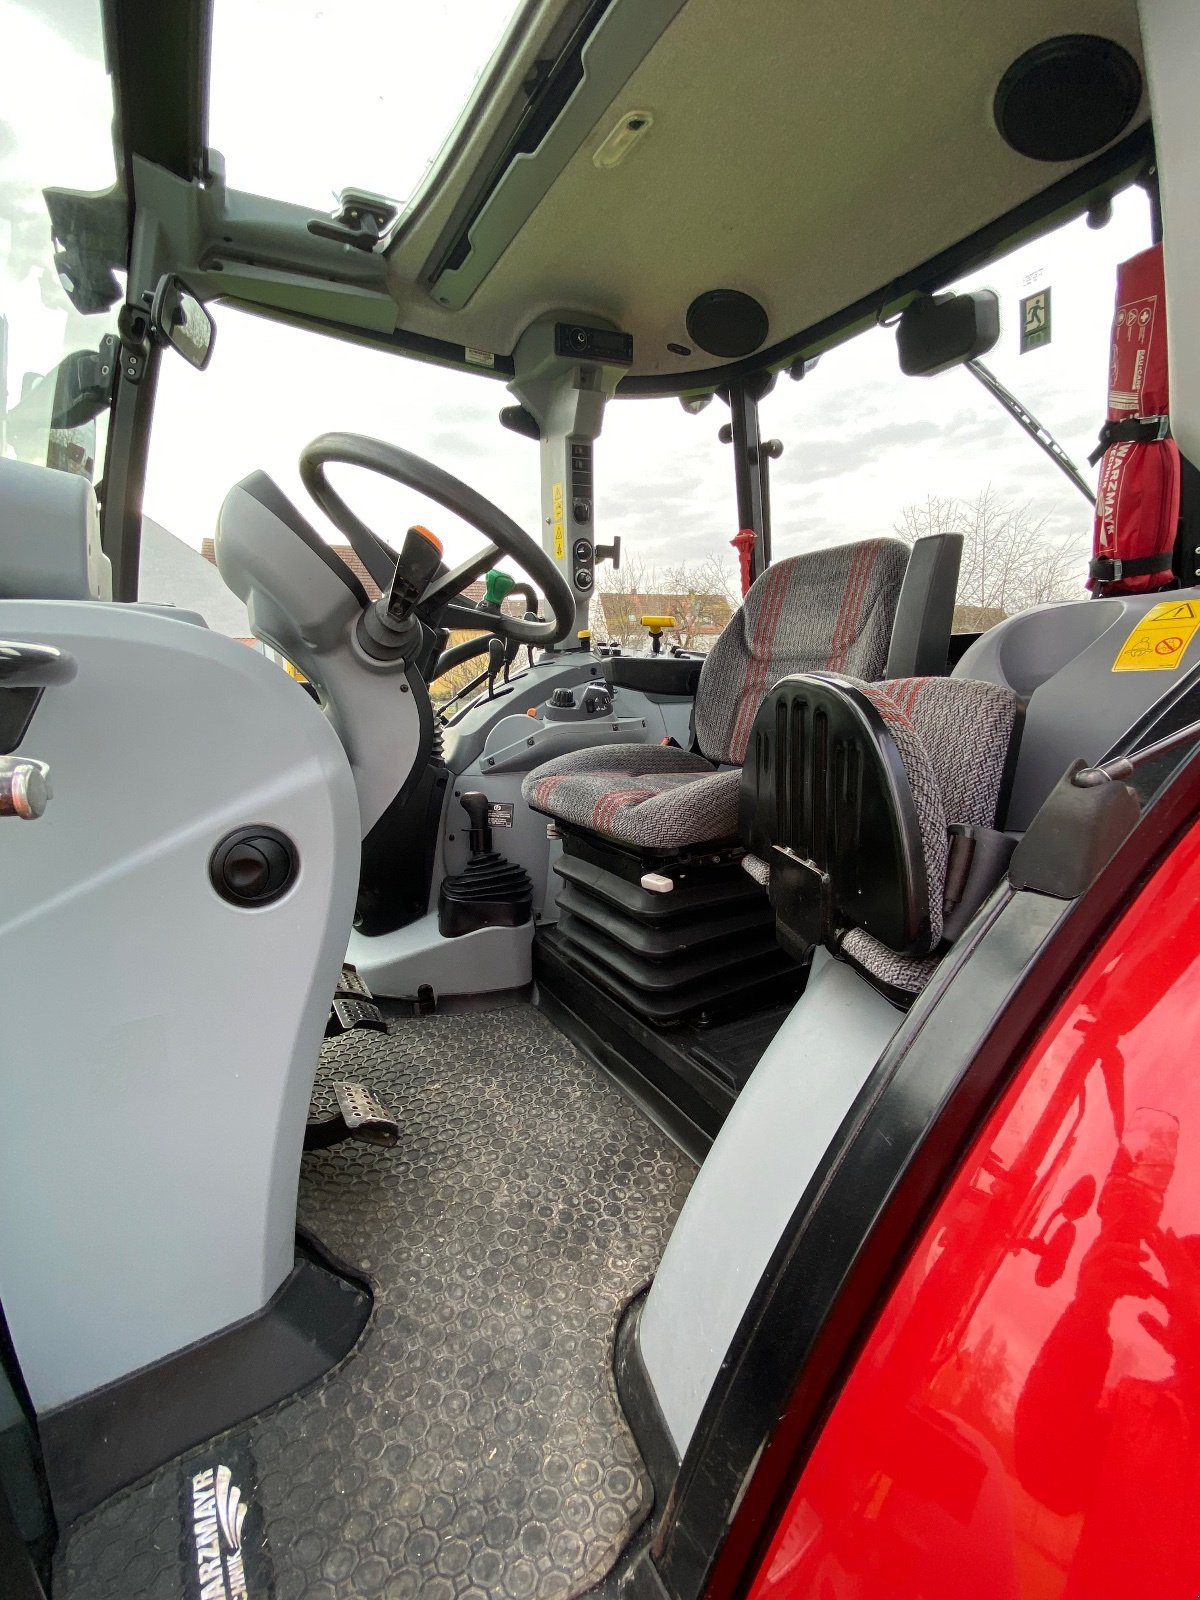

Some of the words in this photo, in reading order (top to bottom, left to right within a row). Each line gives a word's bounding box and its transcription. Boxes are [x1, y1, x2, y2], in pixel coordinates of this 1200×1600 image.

[1103, 443, 1118, 488] TECHNIK
[1104, 441, 1133, 535] WARZMAYR
[193, 1468, 226, 1600] ARZMAYR
